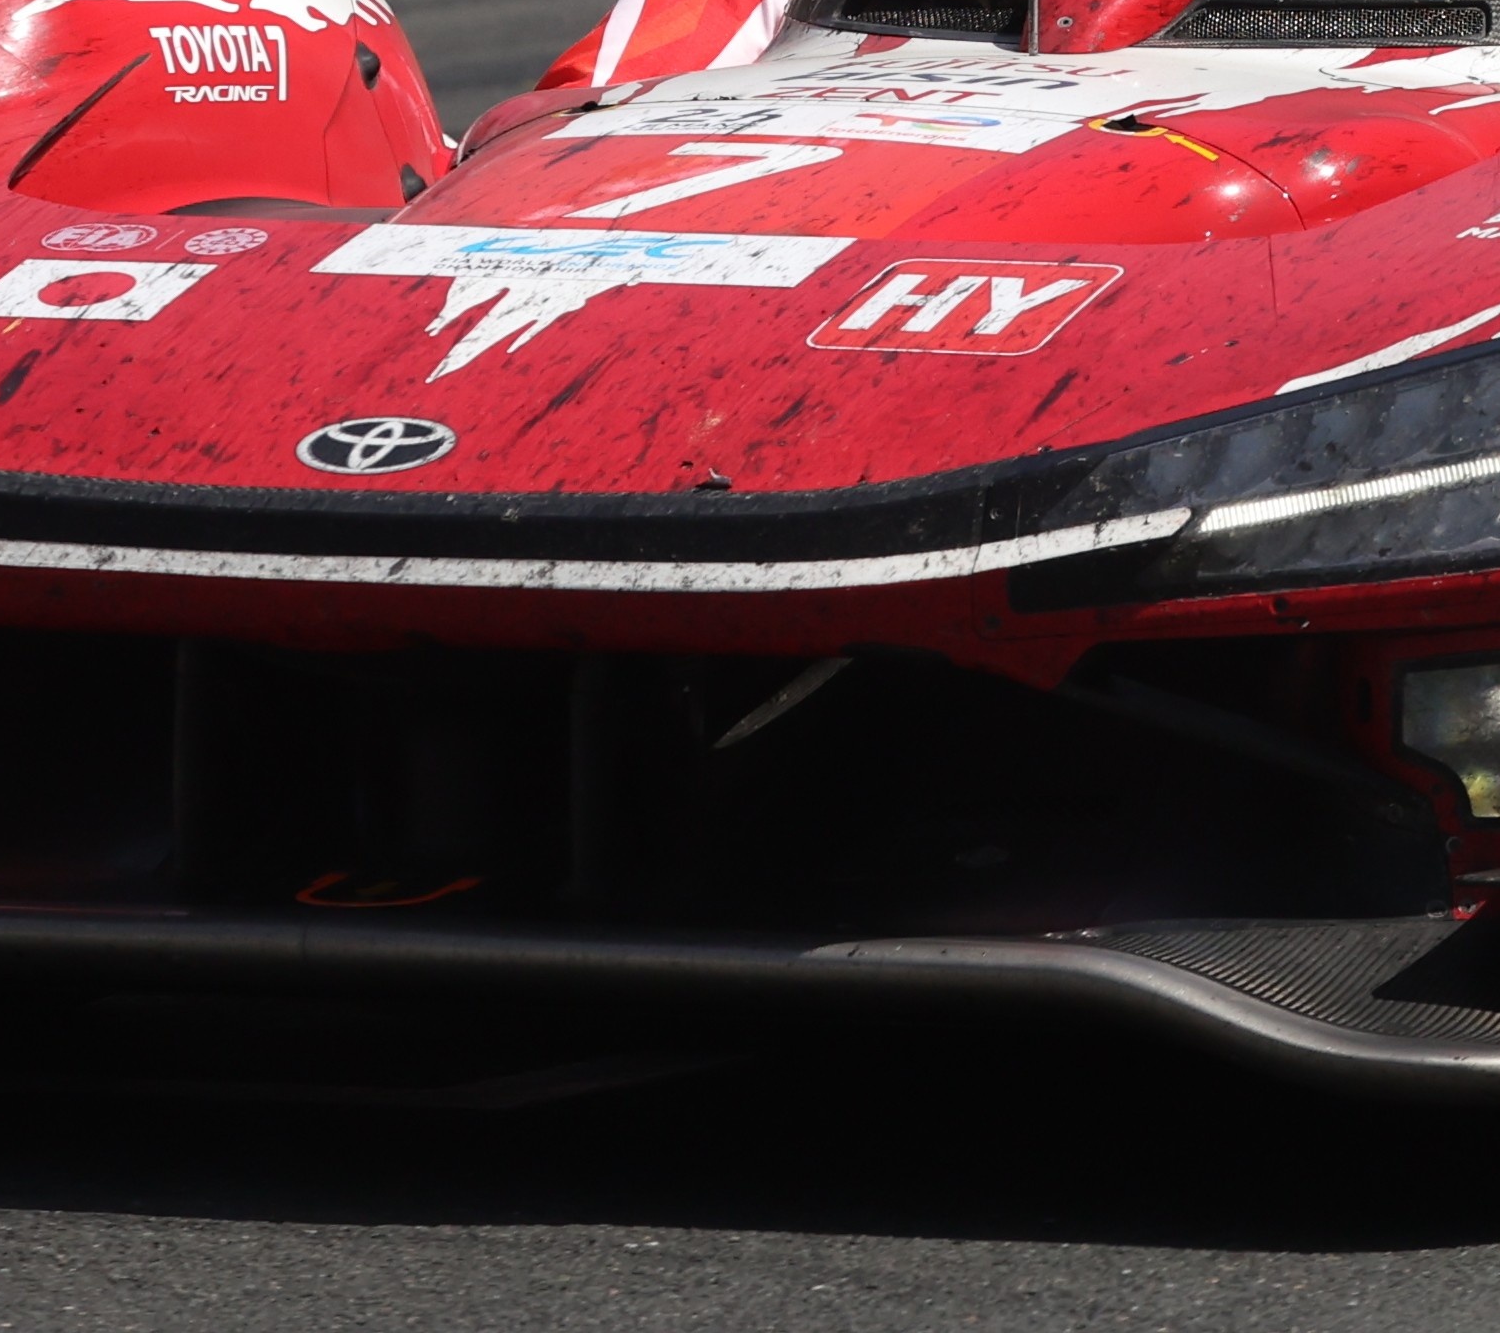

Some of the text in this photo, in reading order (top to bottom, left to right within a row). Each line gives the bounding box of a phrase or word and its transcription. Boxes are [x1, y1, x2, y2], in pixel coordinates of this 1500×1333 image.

[148, 24, 272, 75] TOYOTA
[164, 84, 275, 103] RACING
[752, 85, 1003, 104] ZENT
[770, 71, 1080, 90] AISIN
[564, 141, 844, 220] 7
[838, 273, 1094, 336] HY
